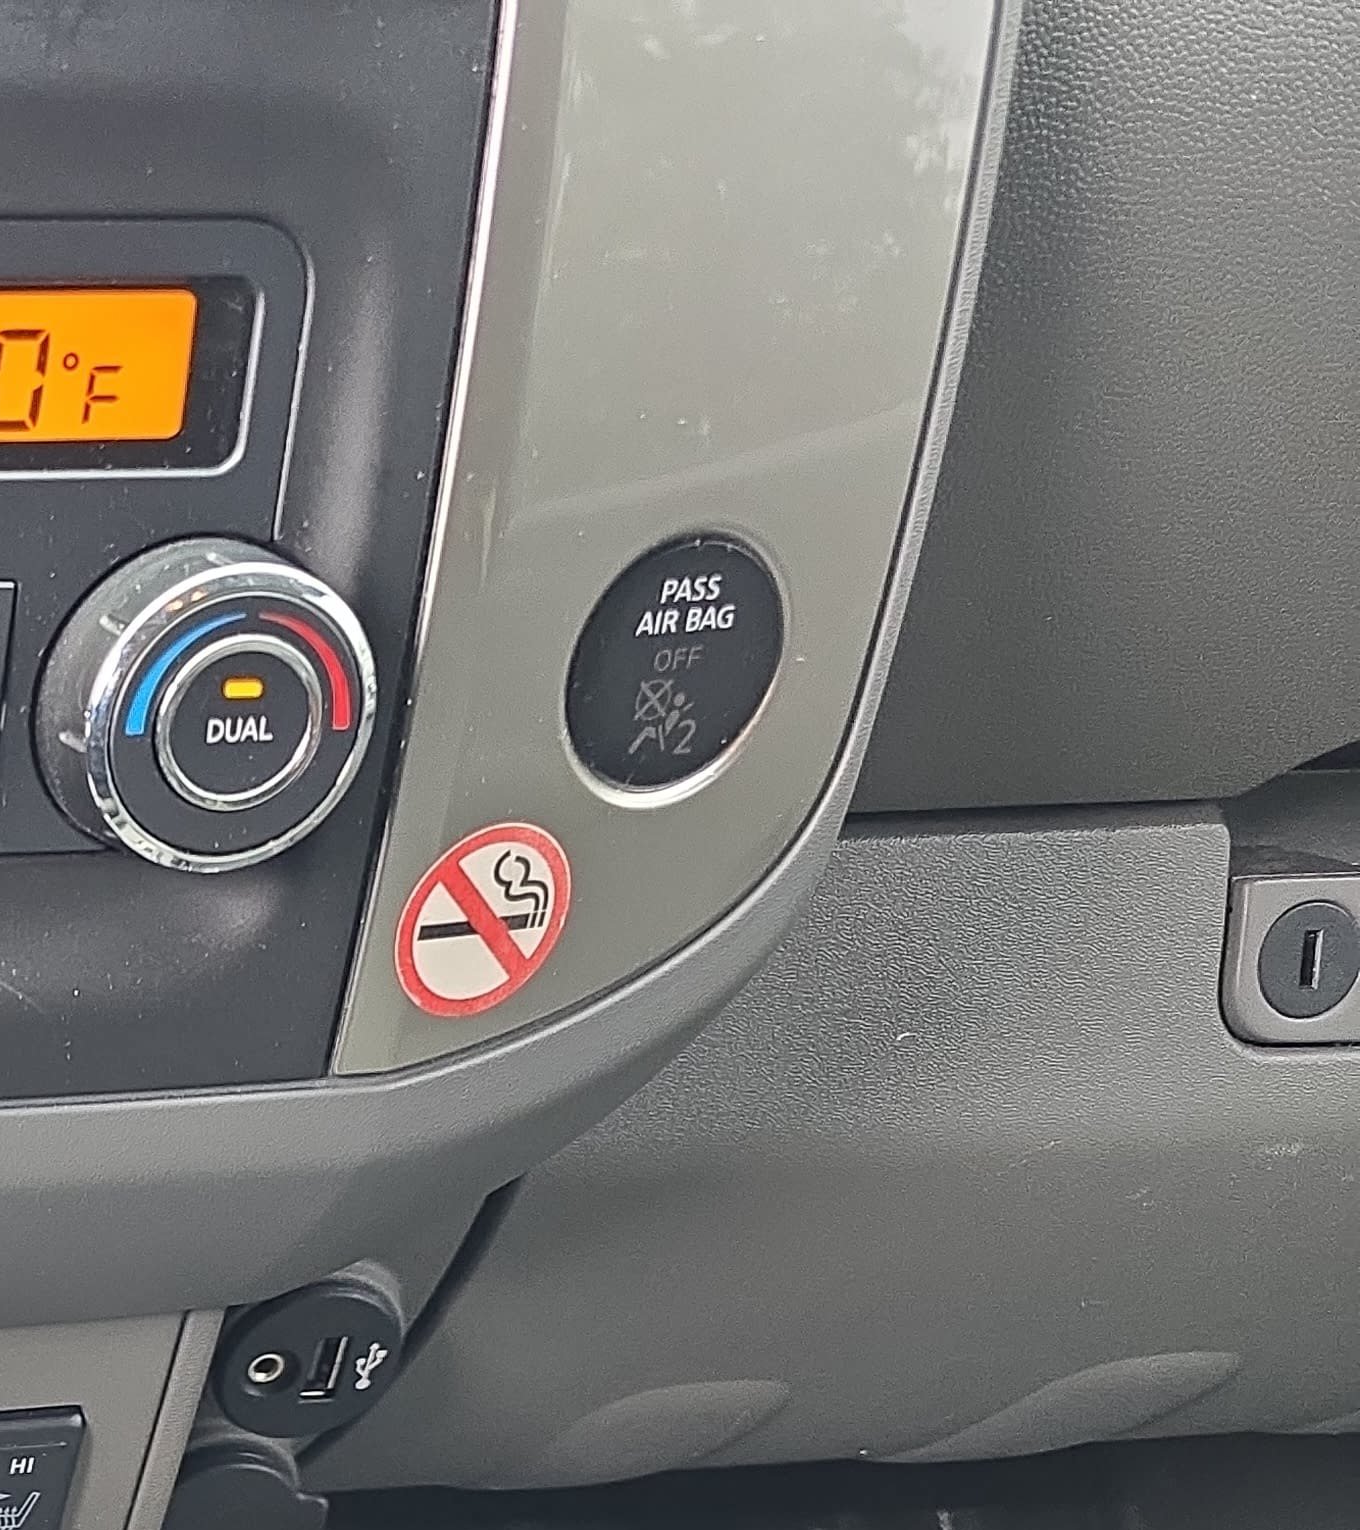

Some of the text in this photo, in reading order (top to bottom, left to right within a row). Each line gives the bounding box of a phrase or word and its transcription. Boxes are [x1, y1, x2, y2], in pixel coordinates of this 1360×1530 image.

[658, 573, 724, 605] PASS
[634, 602, 737, 638] AIR BAG
[653, 643, 705, 673] OFF
[204, 715, 275, 746] DUAL
[9, 1456, 35, 1476] HI
